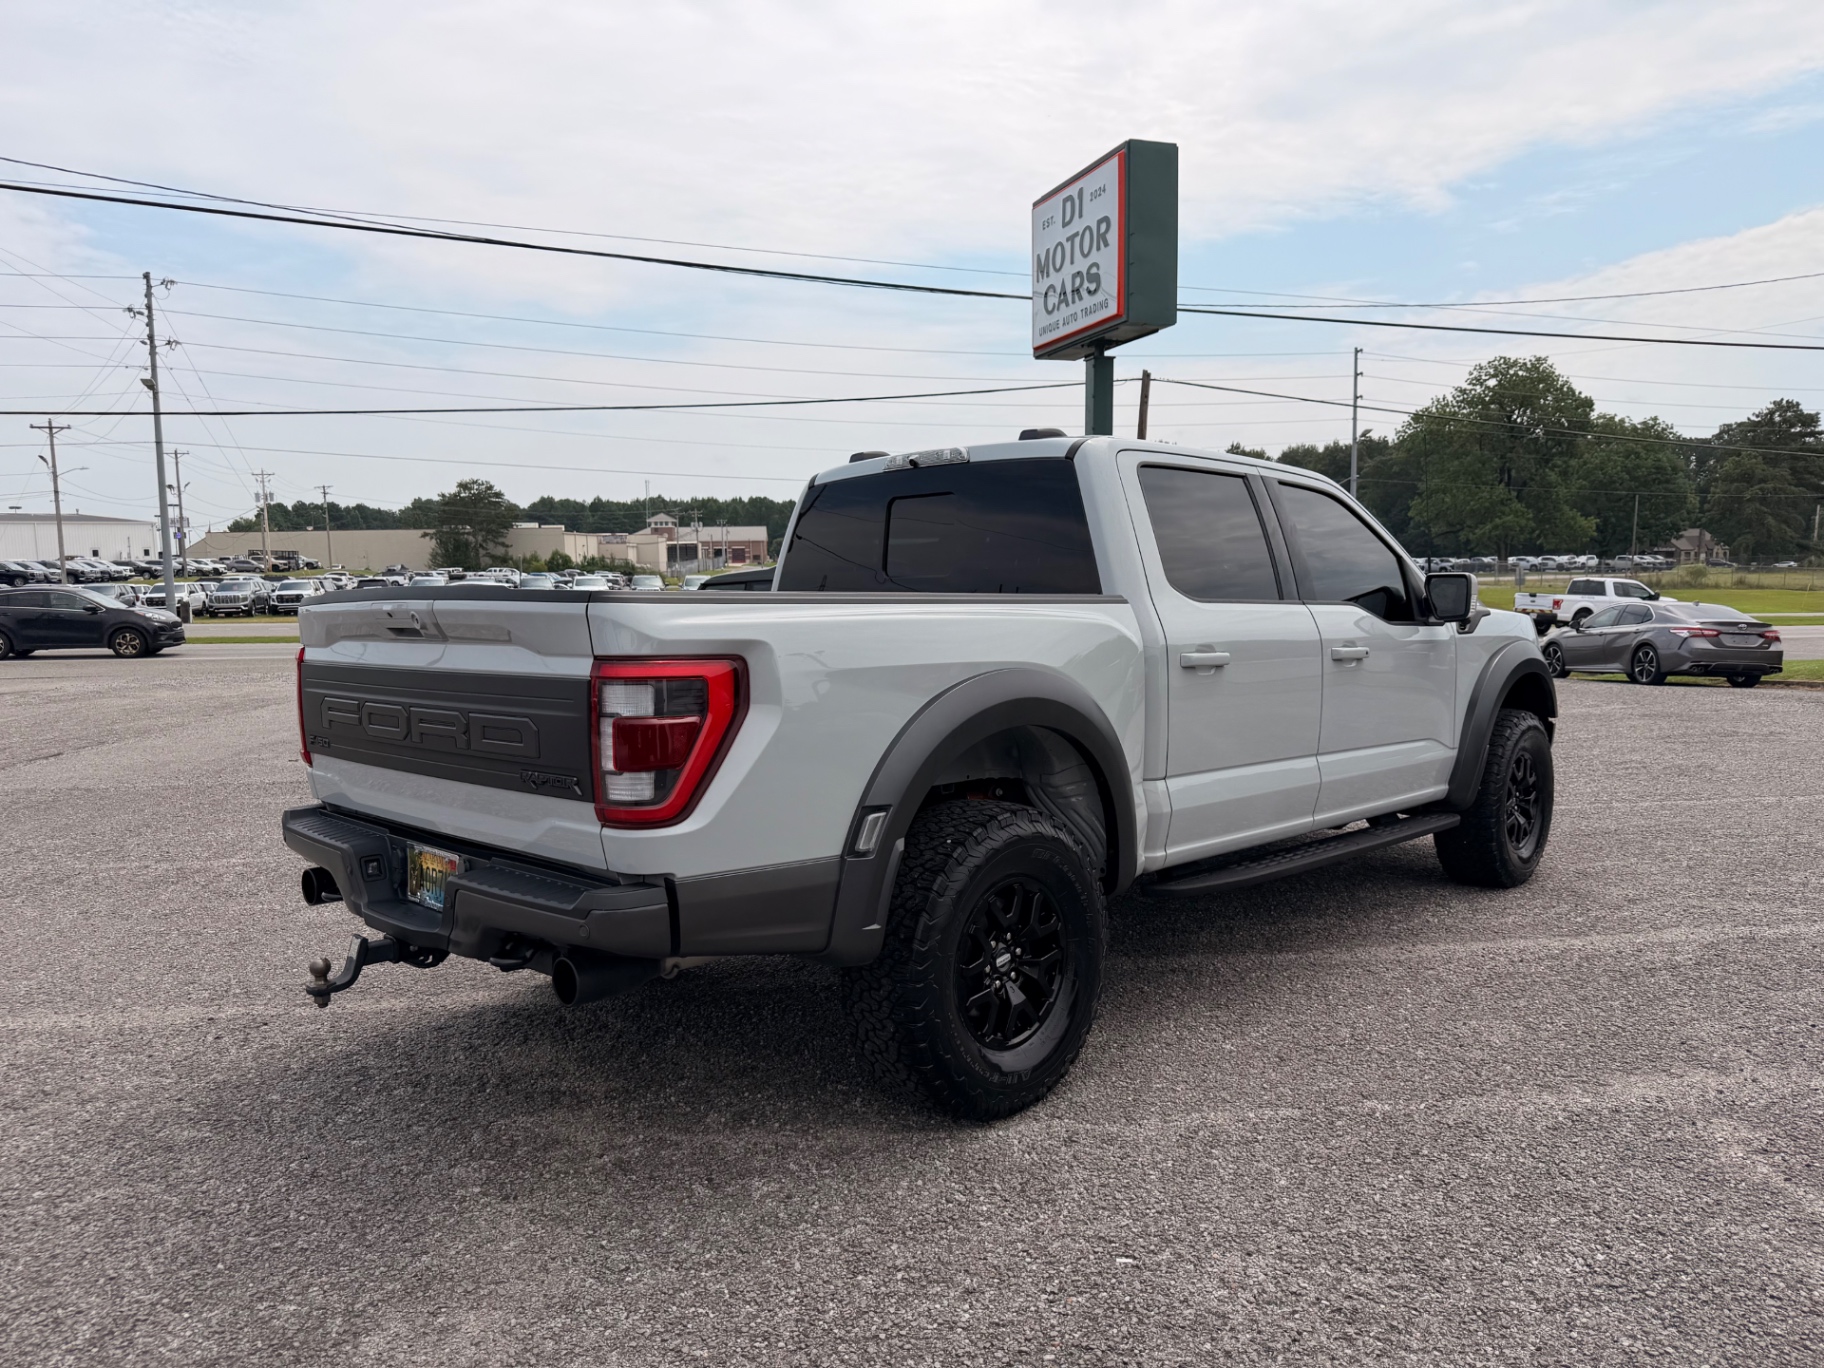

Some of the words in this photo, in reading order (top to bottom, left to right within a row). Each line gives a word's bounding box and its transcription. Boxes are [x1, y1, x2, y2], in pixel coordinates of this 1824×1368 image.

[1042, 215, 1056, 231] EST.
[1061, 186, 1084, 229] D1
[1089, 183, 1107, 202] 2024
[1036, 215, 1112, 284] MOTOR
[1043, 261, 1101, 316] CARS
[1038, 319, 1060, 337] UNIQUE
[1062, 311, 1078, 327] AUTO
[1080, 298, 1109, 320] TRADING
[320, 697, 541, 759] FORD
[519, 768, 584, 797] RAPTOR
